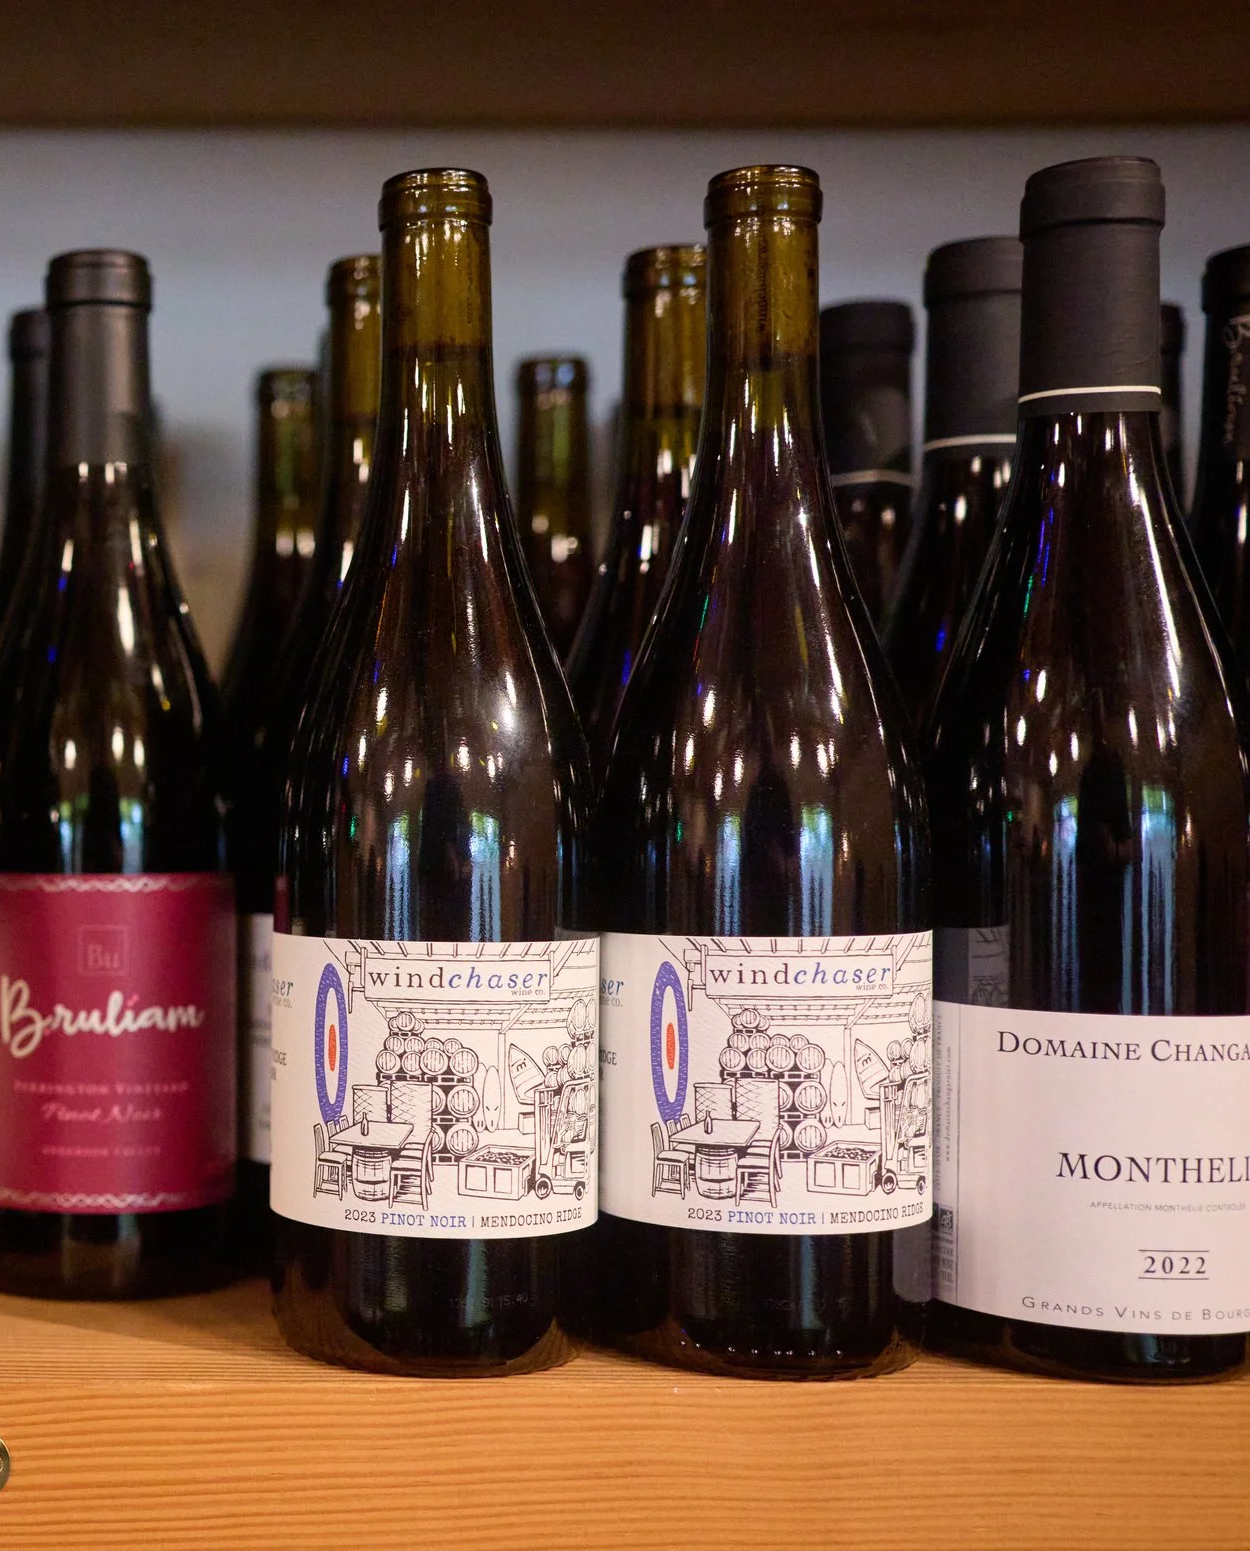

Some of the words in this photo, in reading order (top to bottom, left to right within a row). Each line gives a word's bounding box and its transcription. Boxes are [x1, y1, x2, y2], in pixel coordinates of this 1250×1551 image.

[368, 966, 548, 989] windchaser
[708, 962, 891, 985] windchaser
[511, 988, 533, 996] wine
[534, 988, 546, 996] co.
[855, 983, 878, 992] wine
[879, 983, 890, 991] co.
[997, 1031, 1142, 1061] DOMAINE
[687, 1207, 723, 1222] 2023
[727, 1211, 774, 1224] PINOT
[779, 1211, 817, 1225] NOIR
[830, 1208, 899, 1225] MENDOCINO
[901, 1201, 924, 1219] RIDGE
[1090, 1201, 1152, 1211] APPELLATION
[344, 1208, 376, 1224] 2023
[381, 1212, 425, 1226] PINOT
[430, 1214, 467, 1228] NOIR
[480, 1211, 554, 1228] MENDOCINO
[556, 1207, 582, 1223] RIDGE
[1143, 1256, 1206, 1274] 2022
[1022, 1296, 1104, 1317] GRANDS
[1114, 1306, 1162, 1320] VINS
[1171, 1311, 1192, 1320] DE
